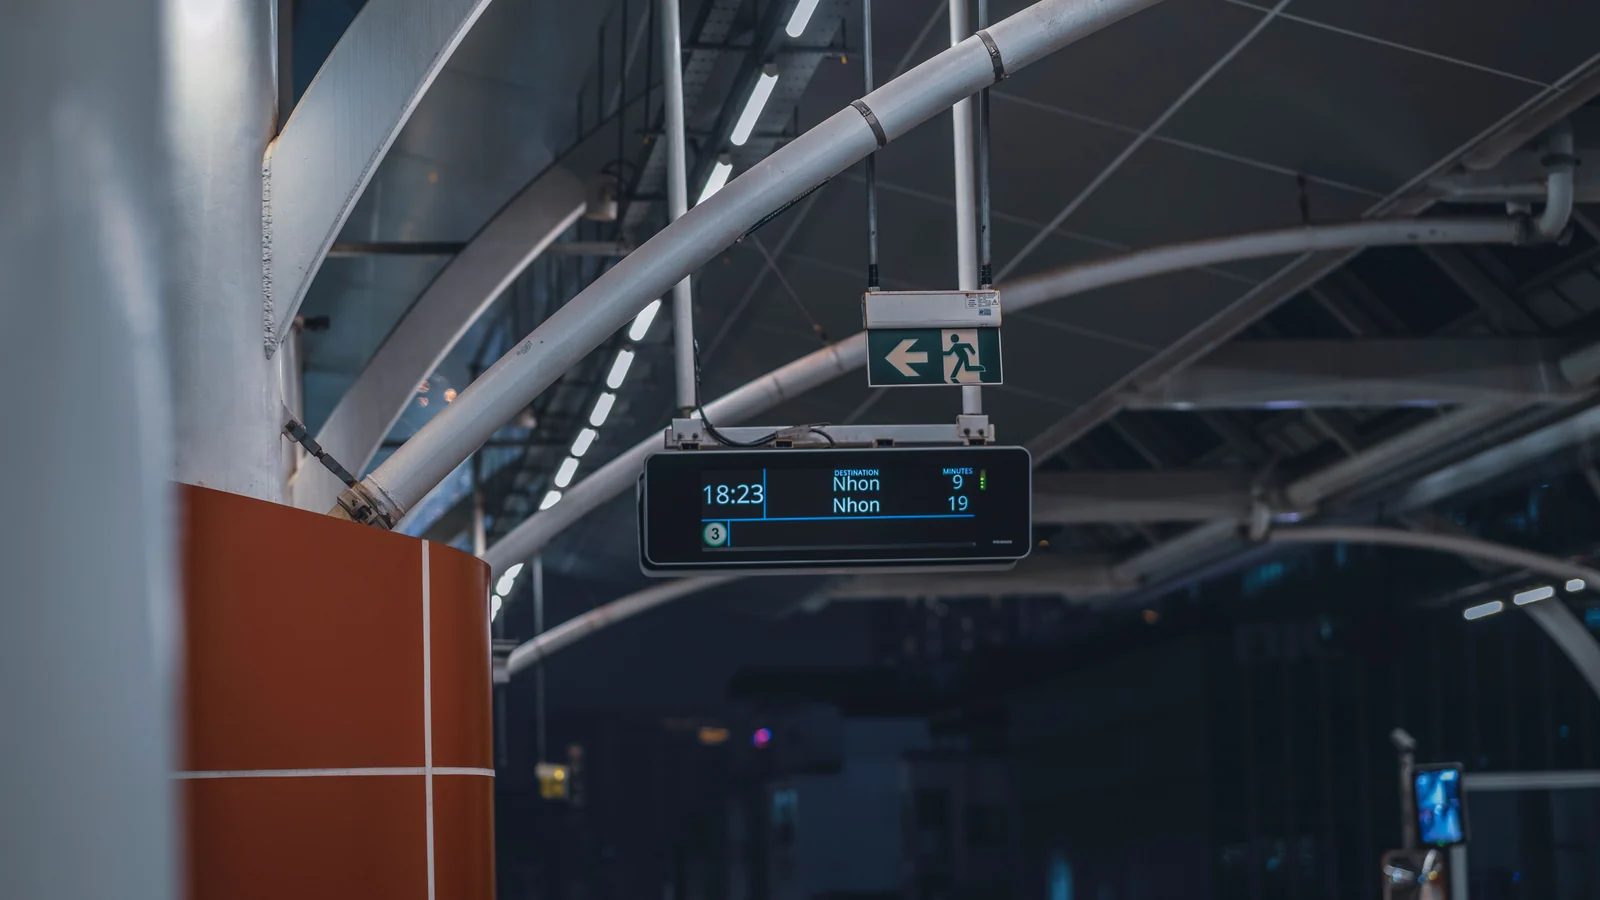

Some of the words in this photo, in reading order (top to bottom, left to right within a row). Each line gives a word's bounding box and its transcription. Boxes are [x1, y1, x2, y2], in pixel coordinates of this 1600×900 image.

[833, 476, 880, 491] Nhon
[952, 474, 963, 490] 9
[703, 484, 764, 505] 18:23
[833, 497, 880, 513] Nhon
[948, 495, 969, 511] 19
[711, 527, 720, 541] 3
